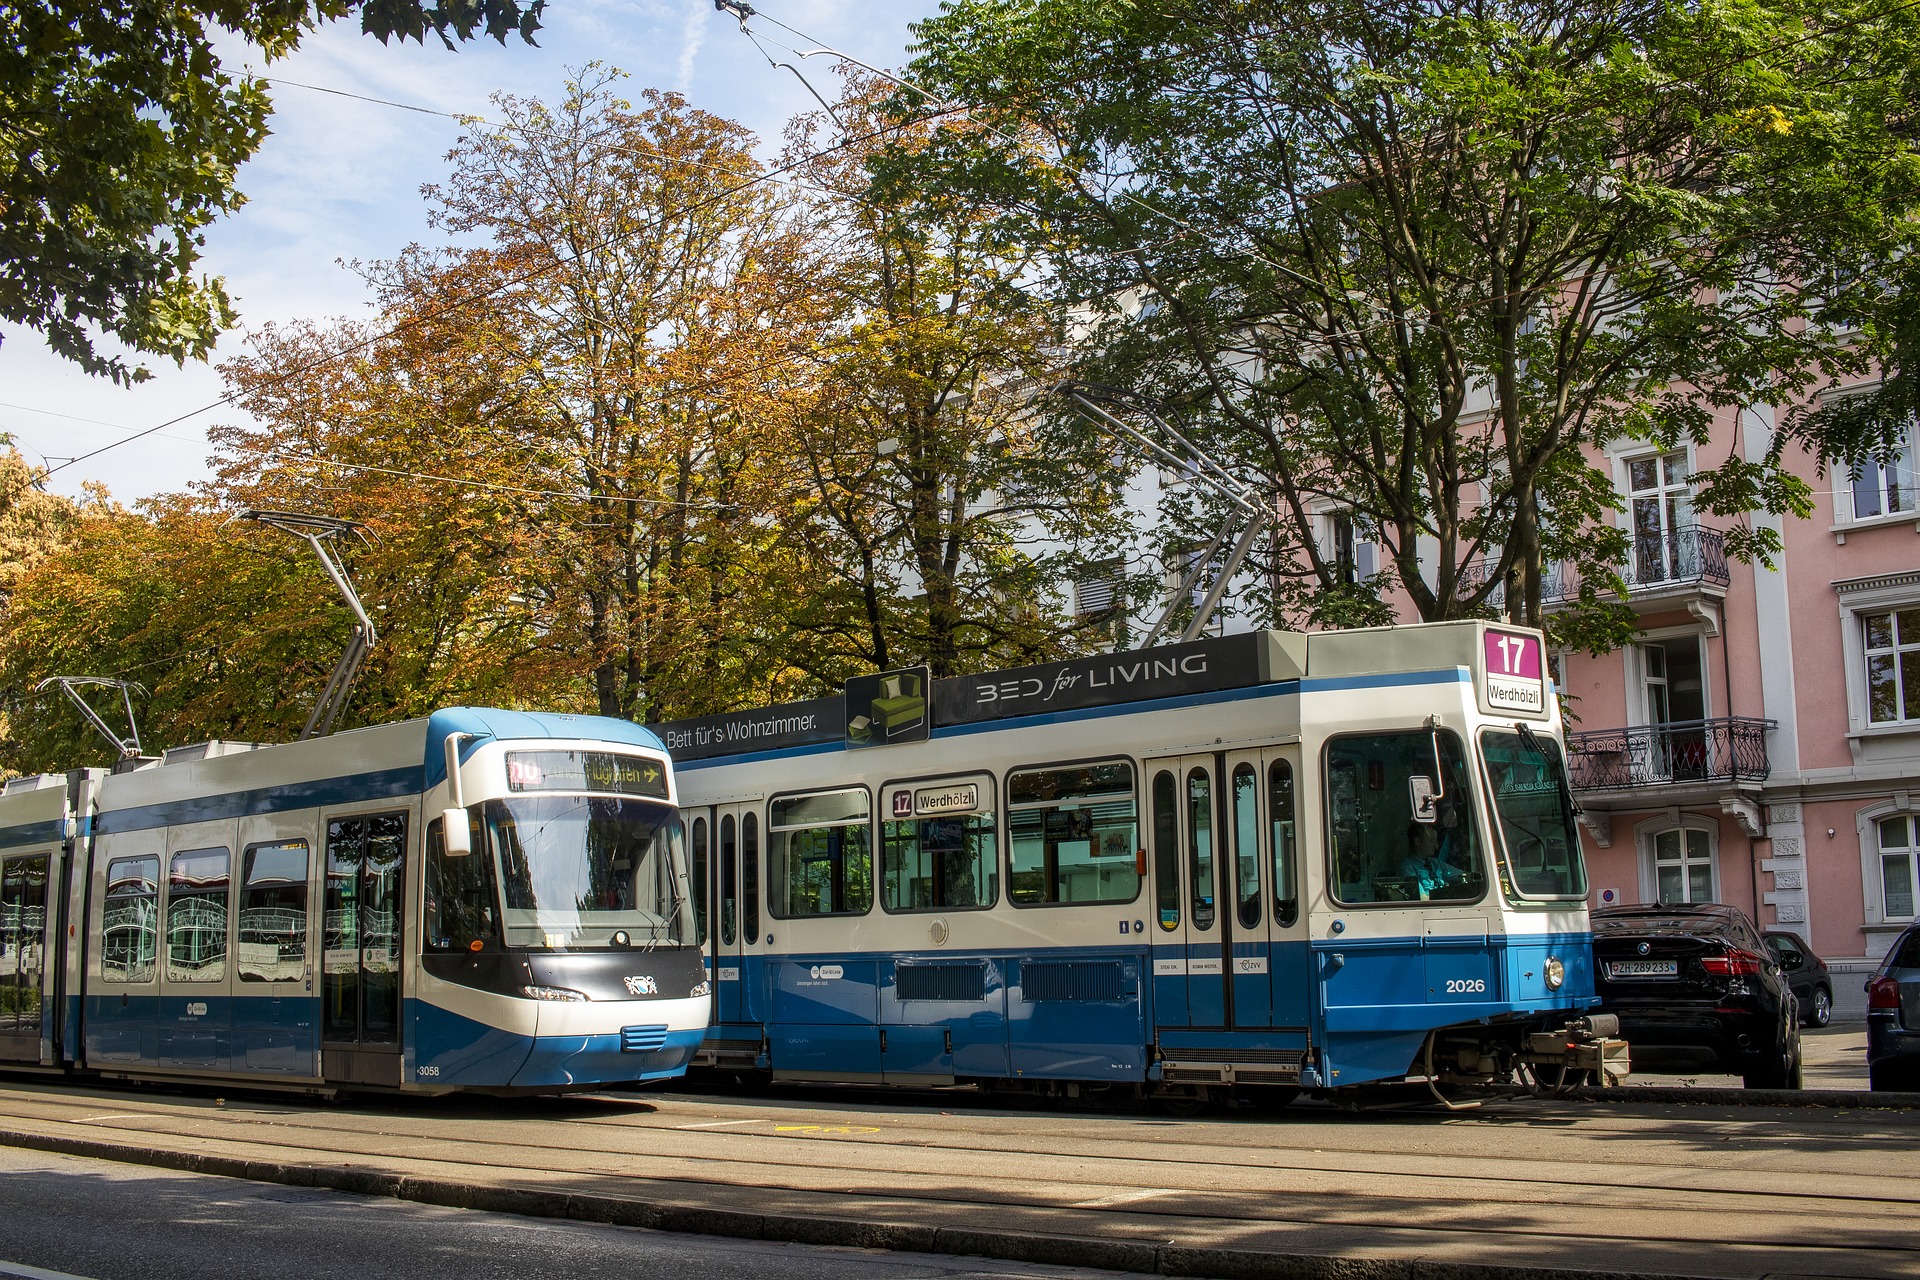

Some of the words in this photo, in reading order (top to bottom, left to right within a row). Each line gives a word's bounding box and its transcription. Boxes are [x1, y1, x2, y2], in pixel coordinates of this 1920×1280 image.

[1497, 635, 1525, 674] 17
[1043, 667, 1082, 701] for
[1089, 653, 1207, 687] LIVING
[1489, 684, 1539, 704] Werdhölzli
[667, 730, 692, 749] Bett
[726, 714, 817, 741] Wohnzimmer.
[894, 794, 911, 813] 17
[920, 791, 974, 808] Werdhölzli
[1446, 979, 1486, 993] 2026
[419, 1066, 440, 1076] 3058
